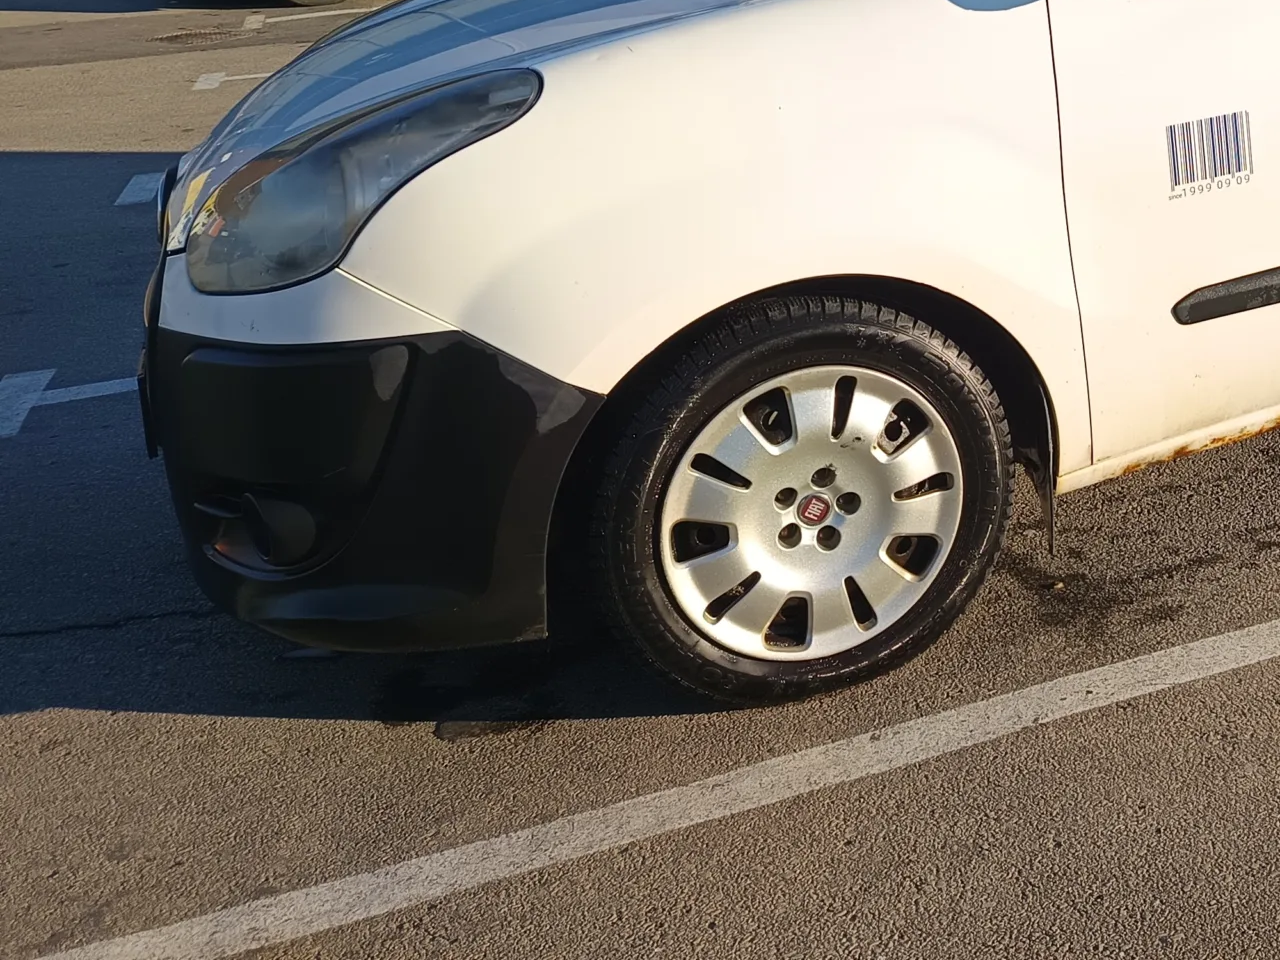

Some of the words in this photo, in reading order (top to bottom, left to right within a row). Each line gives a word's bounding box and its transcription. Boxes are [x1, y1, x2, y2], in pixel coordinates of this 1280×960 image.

[1168, 192, 1183, 201] since
[1182, 182, 1212, 197] 1999
[1216, 178, 1231, 190] 09
[1236, 173, 1250, 184] 09
[804, 498, 826, 521] FIAT
